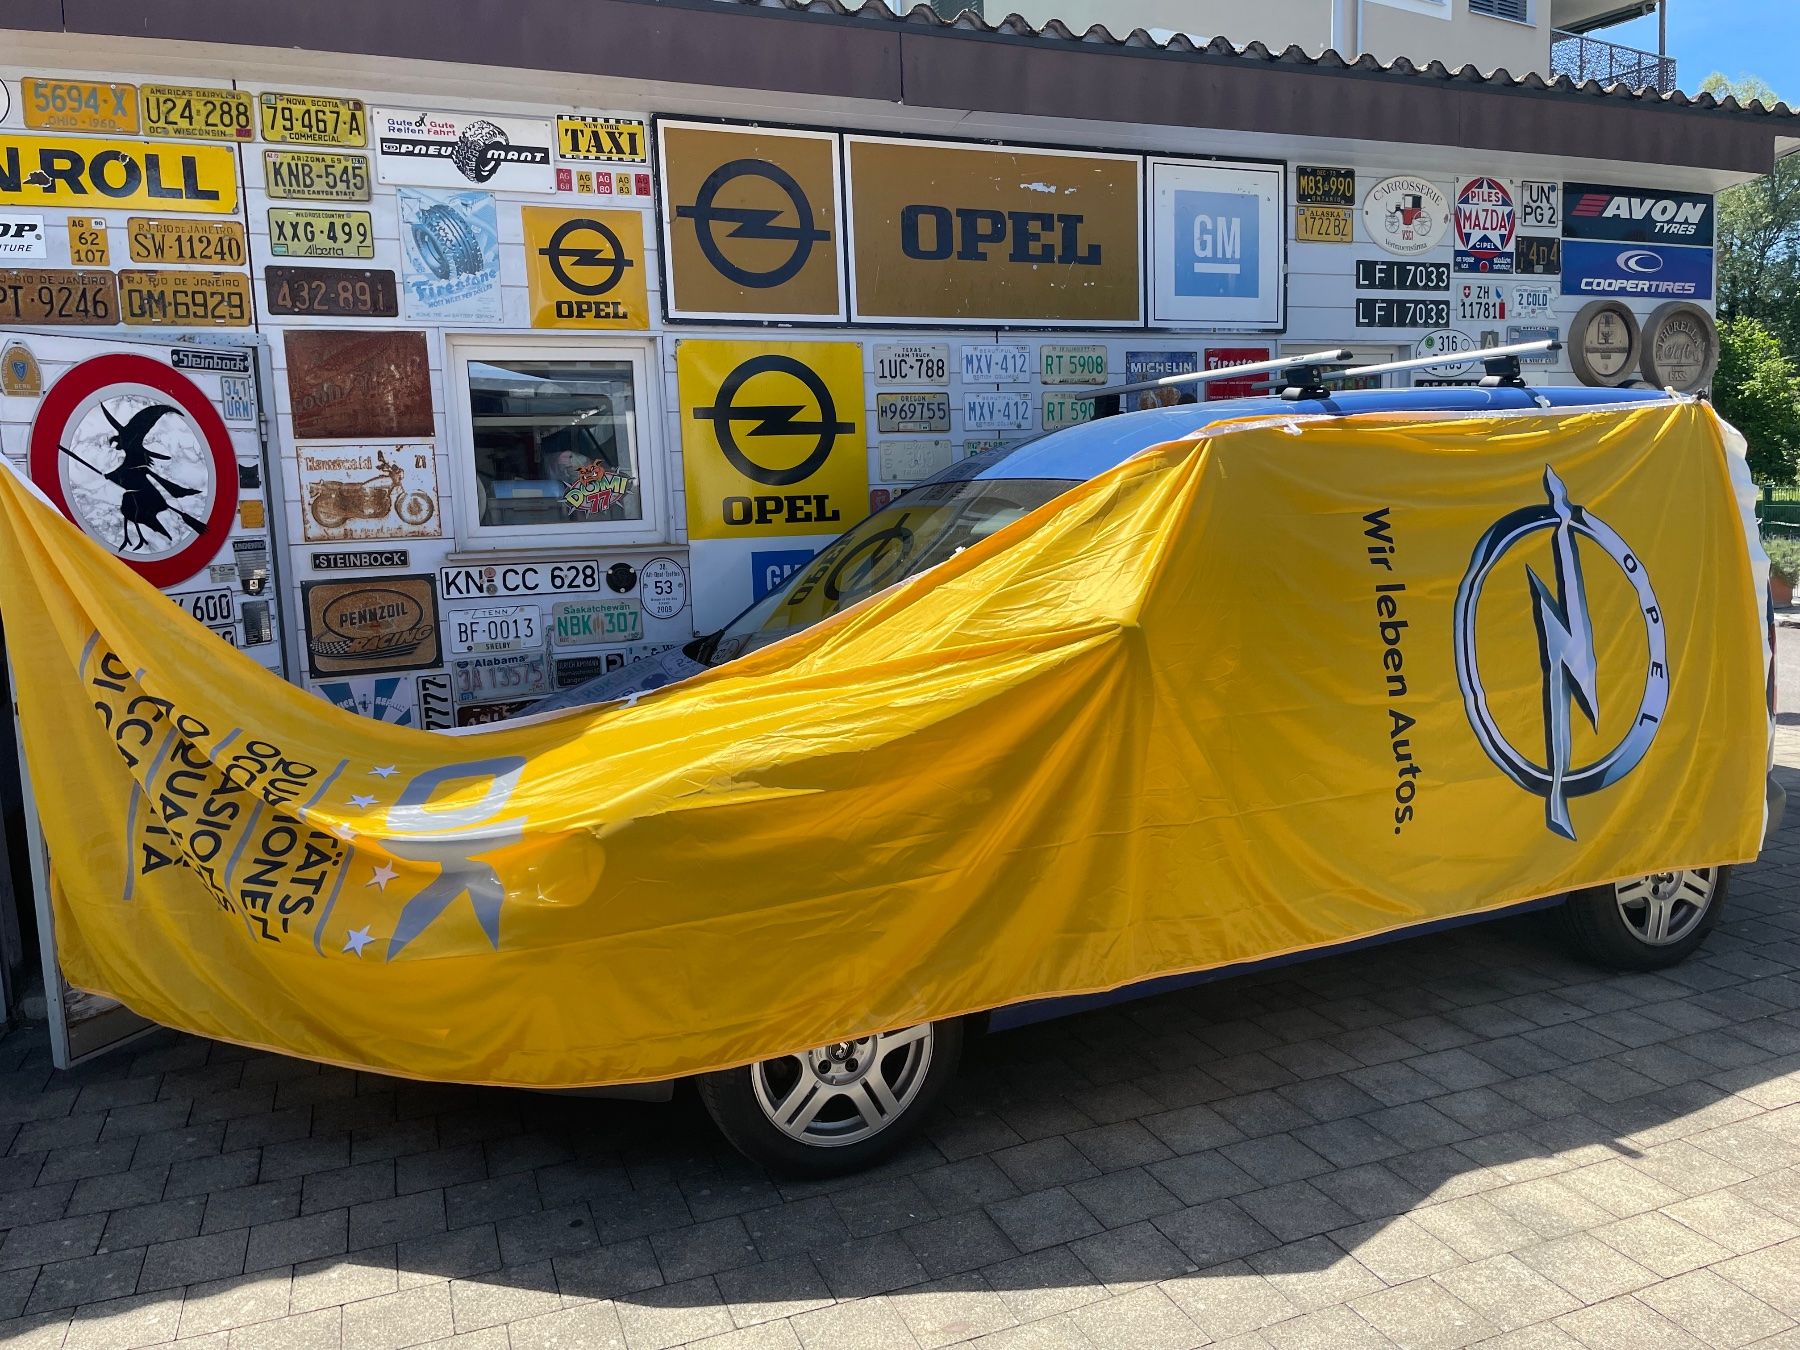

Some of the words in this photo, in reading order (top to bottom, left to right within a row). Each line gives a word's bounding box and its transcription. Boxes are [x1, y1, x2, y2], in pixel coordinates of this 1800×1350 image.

[150, 88, 193, 98] AMERICA'S
[286, 98, 306, 106] NOVA
[311, 100, 339, 108] SCOTIA
[48, 116, 78, 127] OHIO
[388, 119, 412, 127] Gute
[430, 121, 454, 129] Gute
[583, 122, 598, 130] NEW
[601, 123, 620, 131] YORK
[173, 127, 227, 137] WISCONSIN
[289, 133, 341, 142] COMMERCIAL
[389, 126, 424, 134] Reifen
[428, 128, 456, 136] Fahrt
[564, 129, 639, 155] TAXI
[291, 155, 326, 164] ARIZONA
[273, 162, 364, 191] KNB-545
[580, 184, 591, 192] 75
[1374, 180, 1442, 206] CARROSSERIE
[1530, 185, 1550, 203] UN
[1471, 191, 1500, 203] PILES
[1524, 205, 1543, 223] PG
[1548, 207, 1556, 224] 2
[1603, 196, 1707, 224] AVON
[72, 220, 84, 228] AG
[1463, 208, 1507, 231] MAZDA
[900, 204, 1100, 265] OPEL
[1193, 215, 1241, 258] GM
[1654, 223, 1697, 235] TYRES
[78, 232, 99, 246] 62
[0, 244, 33, 252] TURE
[74, 249, 105, 263] 107
[304, 245, 343, 256] Alberta
[40, 276, 54, 284] DE
[58, 277, 106, 285] JANEIRO
[175, 278, 187, 286] DE
[193, 278, 239, 287] JANEIRO
[1406, 266, 1447, 286] 7033
[412, 269, 497, 302] Firestone
[1477, 286, 1490, 299] ZH
[1519, 293, 1524, 305] 2
[1527, 293, 1548, 307] COLD
[556, 301, 628, 319] OPEL
[1406, 304, 1447, 324] 7033
[1461, 302, 1498, 319] 11781
[1439, 336, 1458, 352] 316
[1046, 355, 1063, 374] RT
[1070, 355, 1104, 374] 5908
[1131, 362, 1192, 373] MICHELIN
[224, 380, 246, 397] 341
[227, 401, 249, 418] URN
[1047, 402, 1065, 421] RT
[1071, 402, 1097, 420] 590
[586, 489, 612, 513] 77
[722, 494, 840, 526] OPEL
[1362, 507, 1396, 572] Wir
[320, 552, 402, 567] STEINBOCK
[445, 569, 484, 597] KN
[503, 568, 540, 591] CC
[550, 565, 596, 589] 628
[655, 580, 673, 595] 53
[193, 594, 230, 622] 600
[340, 602, 408, 627] PENNZOIL
[563, 604, 631, 615] Saskatchewan
[557, 615, 592, 637] NBK
[606, 612, 639, 633] 307
[351, 624, 433, 653] RACING
[485, 642, 511, 650] SHELBY
[1376, 583, 1409, 697] leben
[474, 655, 526, 668] Alabama
[1389, 709, 1423, 835] Autos.
